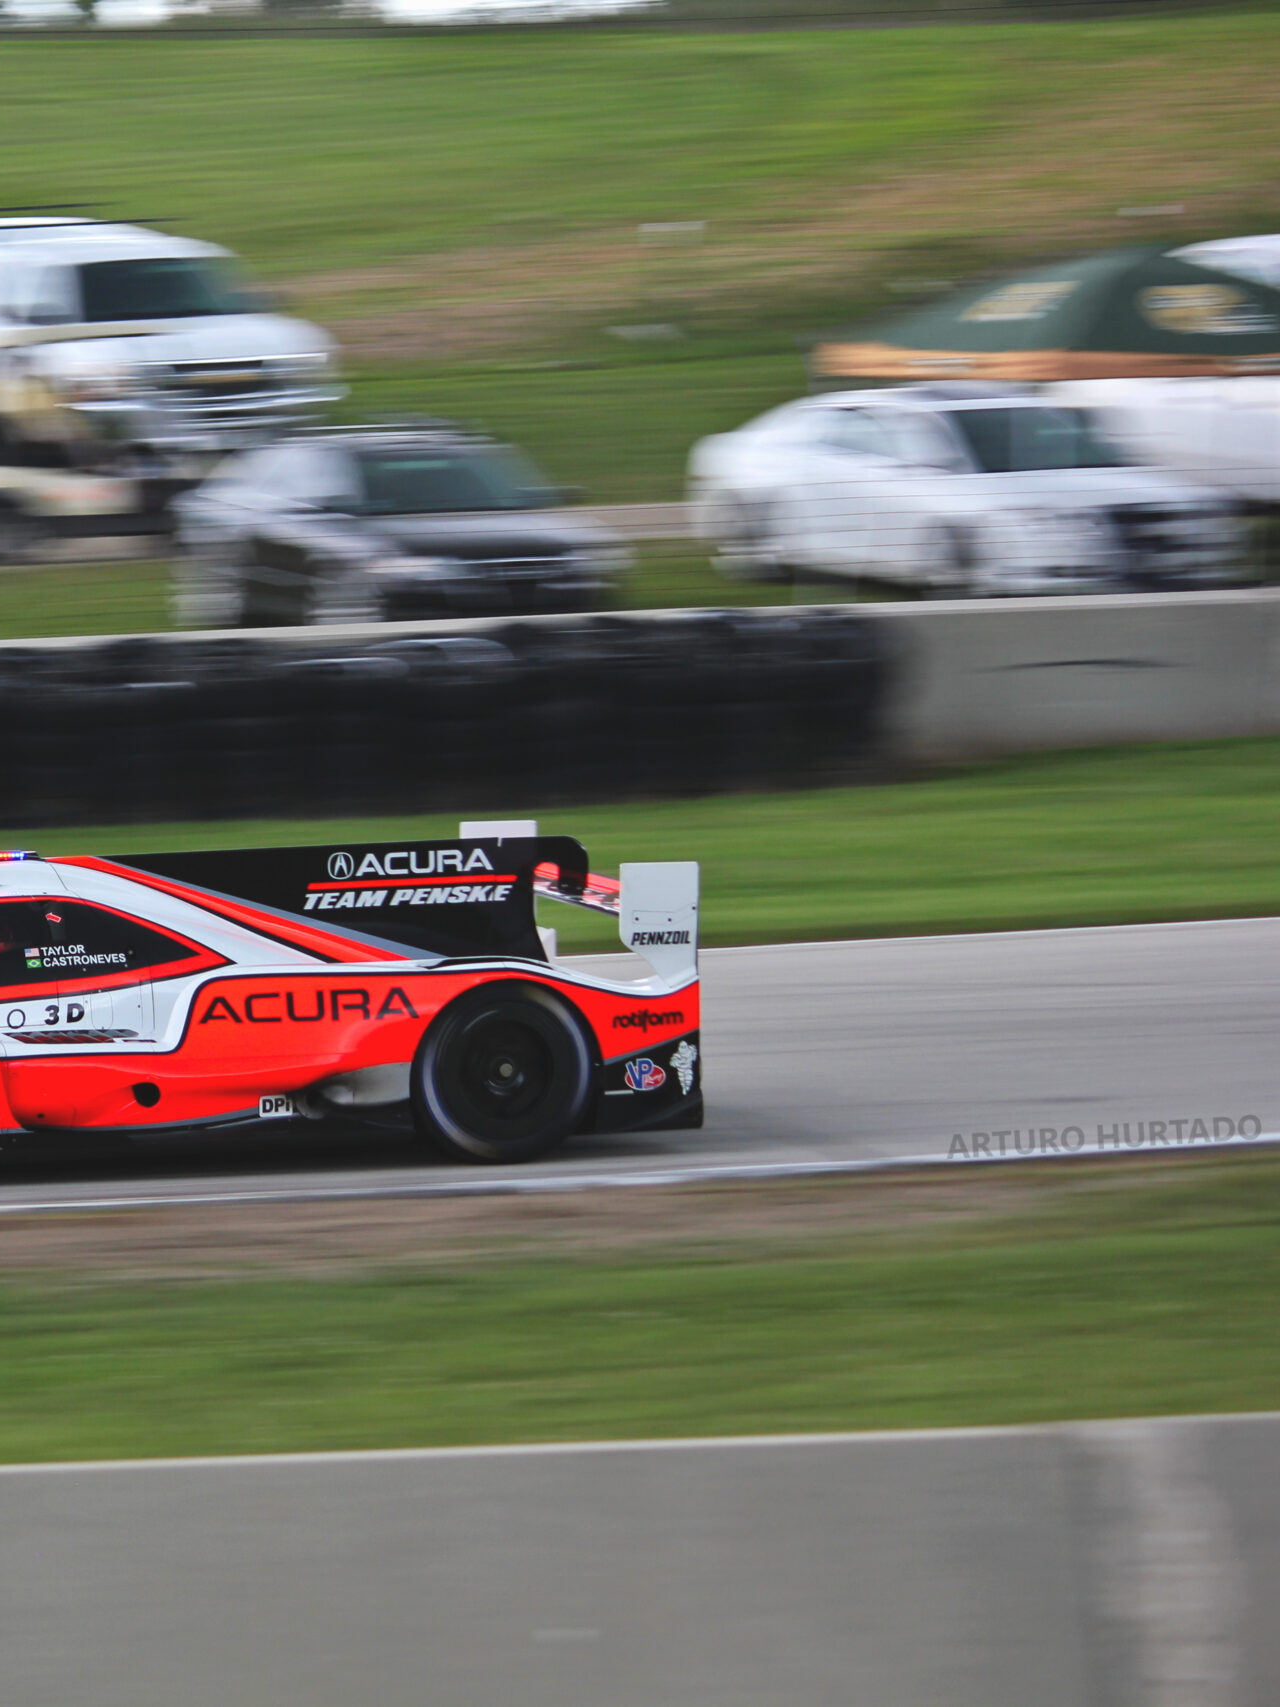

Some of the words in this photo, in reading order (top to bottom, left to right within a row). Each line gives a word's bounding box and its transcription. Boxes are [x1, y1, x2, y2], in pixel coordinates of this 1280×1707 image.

[355, 848, 494, 877] ACURA
[303, 890, 389, 910] TEAM
[389, 884, 513, 906] PENSKE
[40, 944, 86, 956] TAYLOR
[631, 930, 691, 946] PENNZOIL
[43, 953, 127, 968] CASTRONEVES
[44, 1003, 85, 1026] 3D
[199, 986, 420, 1024] ACURA
[612, 1009, 685, 1034] rotiform
[625, 1058, 655, 1089] VP
